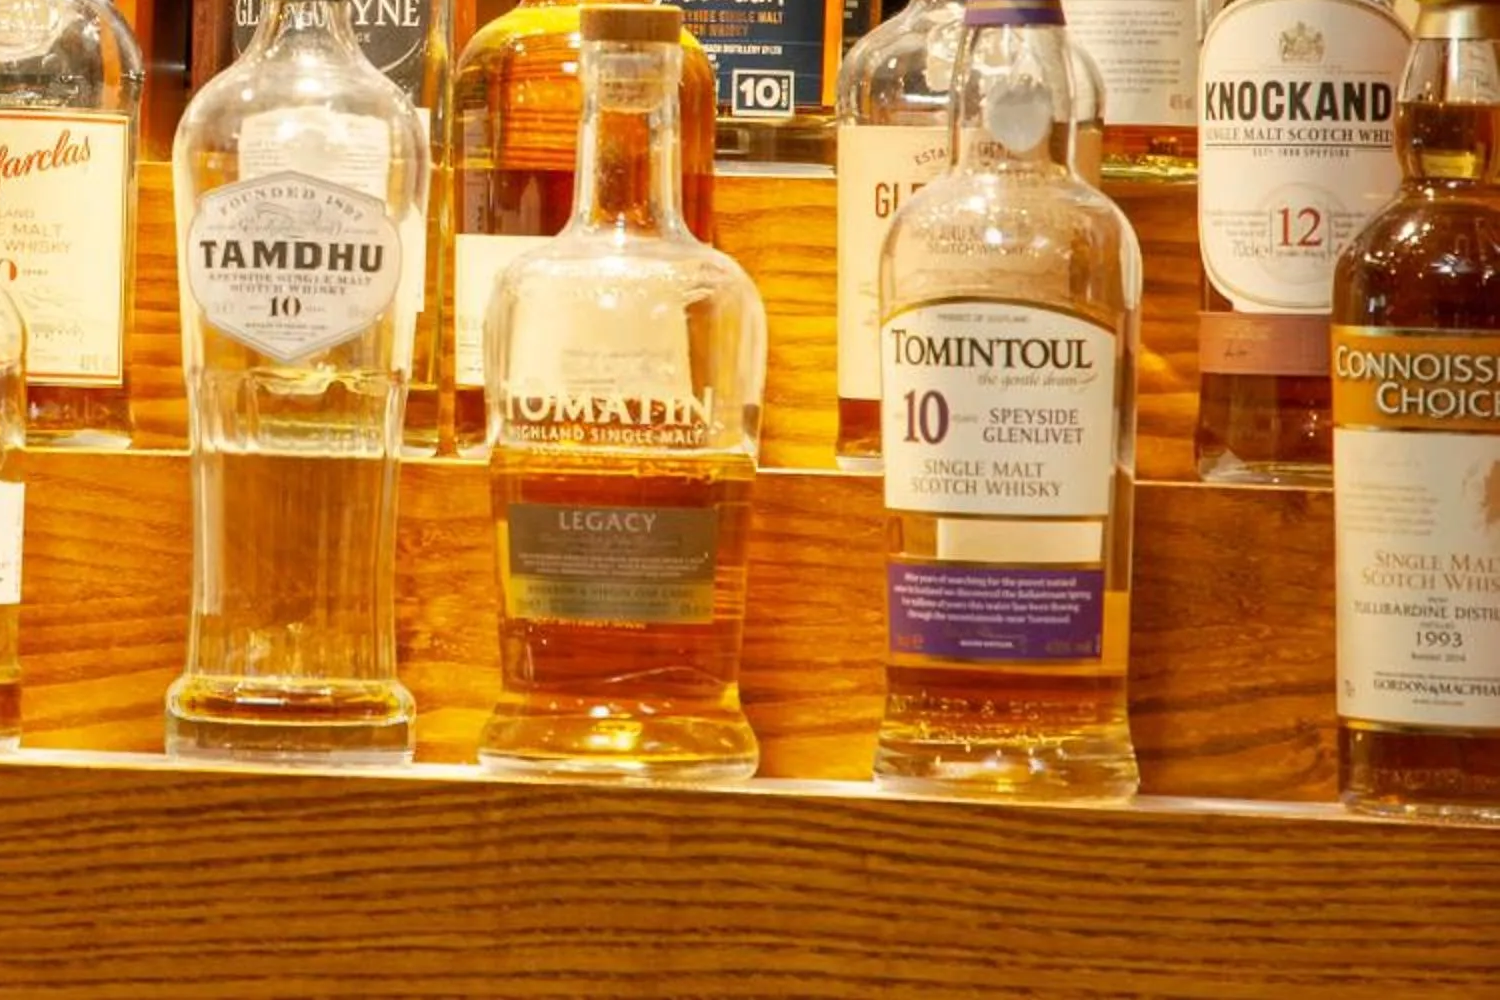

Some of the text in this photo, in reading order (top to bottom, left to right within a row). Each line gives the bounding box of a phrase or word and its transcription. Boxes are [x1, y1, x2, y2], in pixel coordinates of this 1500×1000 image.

[740, 78, 781, 107] 10
[1206, 81, 1391, 122] KNOCKAND
[1244, 128, 1352, 142] MALT SCOTCH
[221, 186, 315, 215] FOUNDED
[13, 223, 62, 237] MALT
[1278, 207, 1322, 247] 12
[4, 241, 71, 253] WHISKY
[200, 240, 384, 272] TAMDHU
[289, 284, 346, 296] WHISKY
[339, 277, 372, 285] MALT
[270, 297, 300, 317] 10
[891, 329, 1093, 369] TOMINTOUL
[1337, 346, 1500, 383] CONNOISS
[978, 372, 997, 385] the
[1001, 375, 1041, 389] gentle
[903, 389, 1079, 445] 10 SPEYSIDE
[983, 428, 1084, 445] GLENLIVET
[924, 461, 1044, 478] SINGLE MALT
[912, 478, 1062, 497] SCOTCH WHISKY
[558, 511, 657, 532] LEGACY
[1375, 550, 1442, 570] SINGLE
[1363, 569, 1435, 589] SCOTCH
[1416, 632, 1463, 647] 1993
[1374, 679, 1426, 691] GORDON
